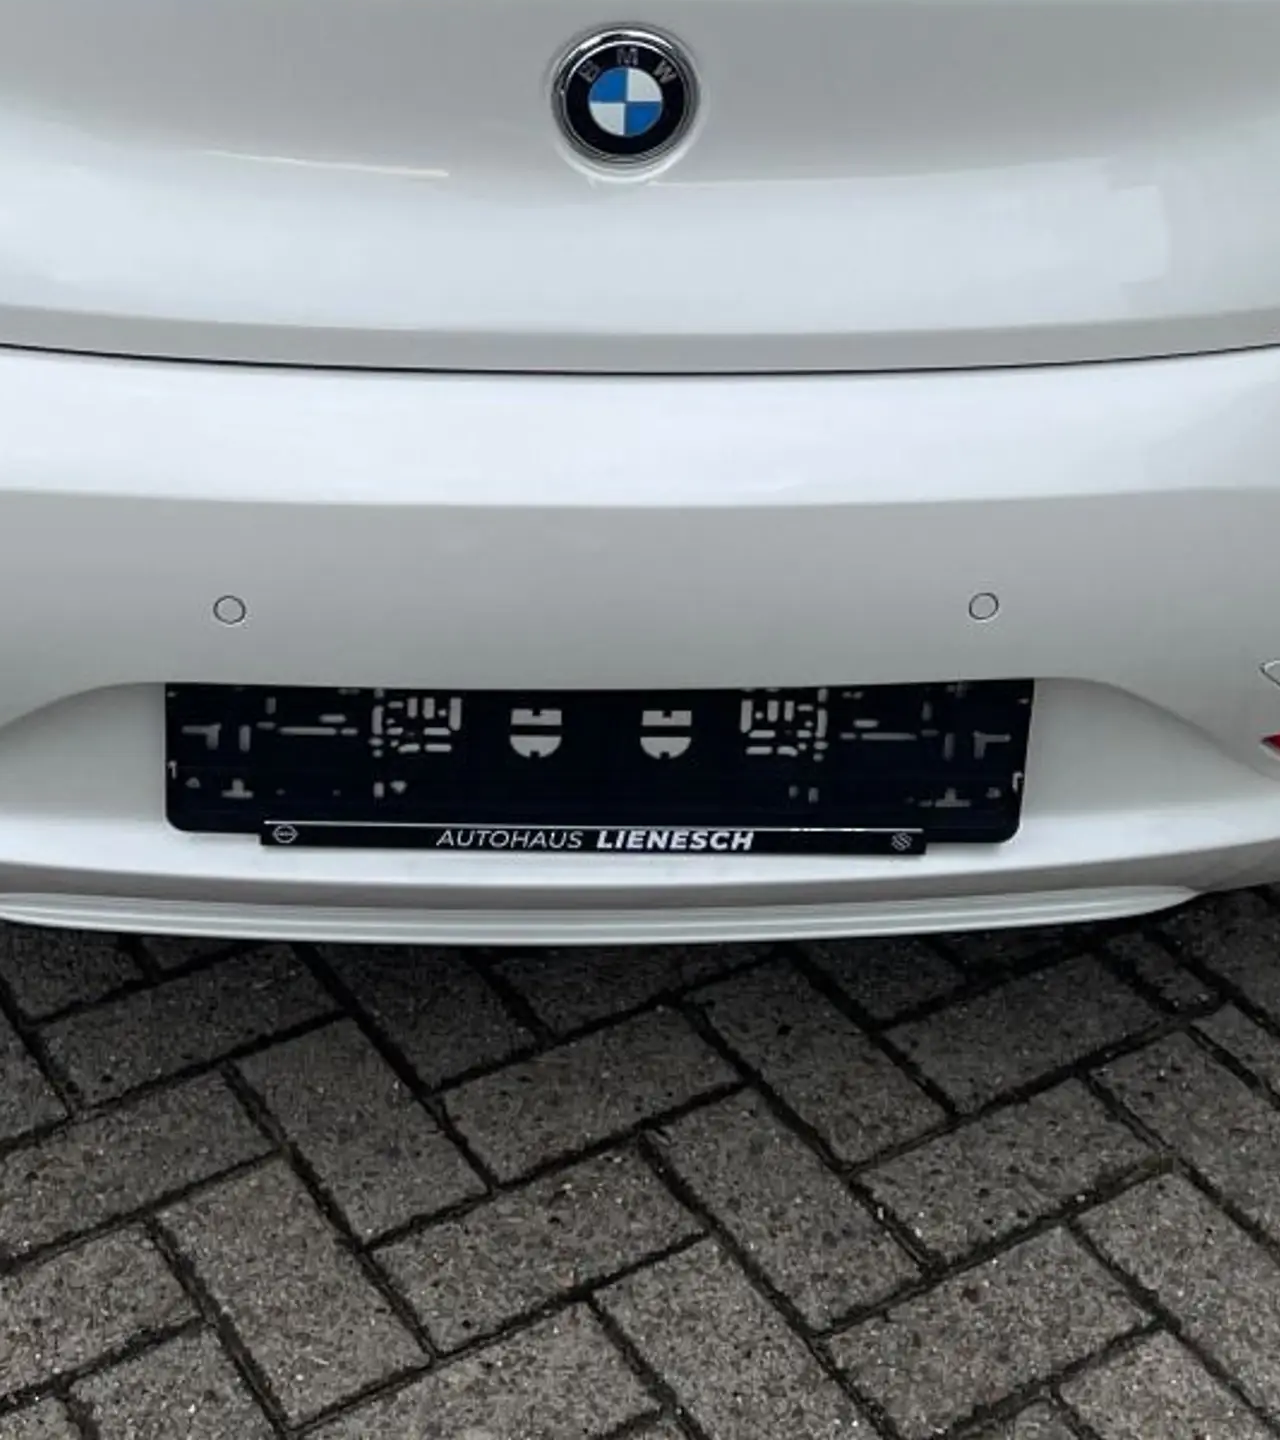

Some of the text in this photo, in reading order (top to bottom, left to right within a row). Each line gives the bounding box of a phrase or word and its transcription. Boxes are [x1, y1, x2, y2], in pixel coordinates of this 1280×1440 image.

[577, 46, 678, 84] BMW
[436, 829, 755, 851] AUTOHAUS LIENESCH
